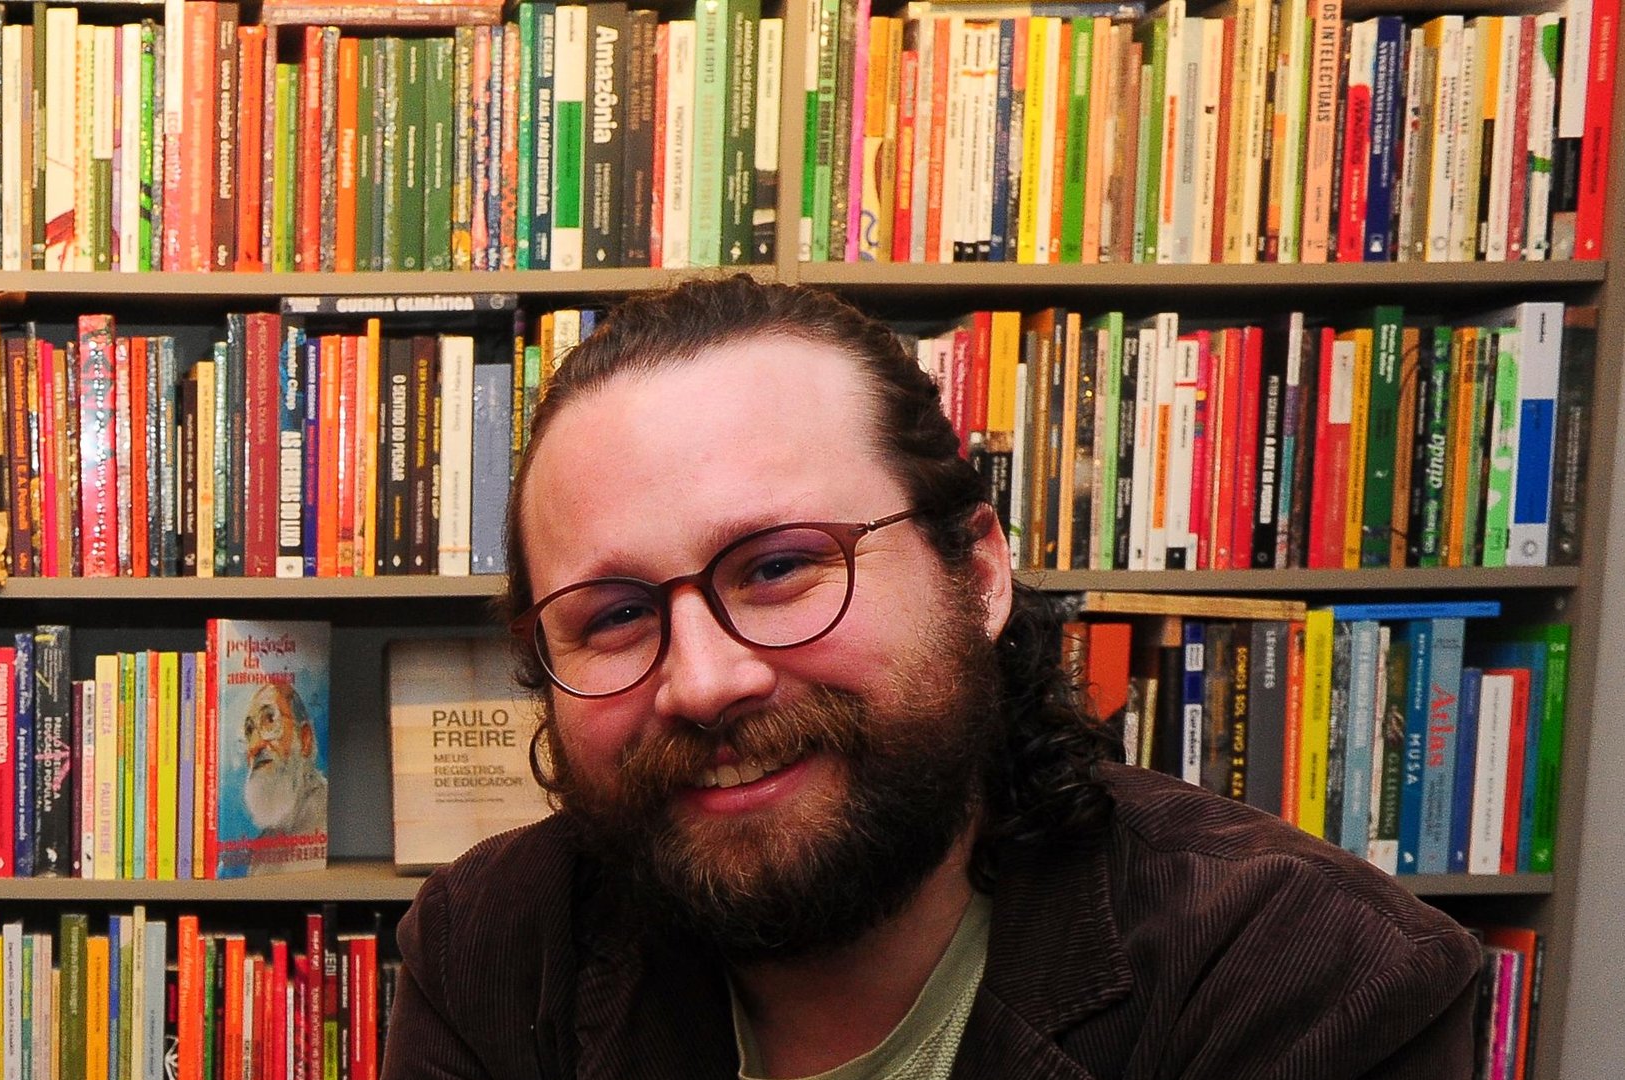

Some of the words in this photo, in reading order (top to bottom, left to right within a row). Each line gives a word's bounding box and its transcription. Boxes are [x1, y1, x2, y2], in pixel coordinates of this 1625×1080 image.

[1321, 3, 1335, 22] OS
[1316, 26, 1335, 123] INTELECTUAIS
[593, 25, 619, 144] Amazônia
[432, 709, 509, 728] PAULO
[433, 729, 516, 748] FREIRE
[434, 753, 469, 764] MEUS
[1406, 733, 1422, 786] MUSA
[434, 765, 505, 776] REGISTROS
[434, 777, 451, 788] DE
[453, 777, 524, 788] EDUCADOR
